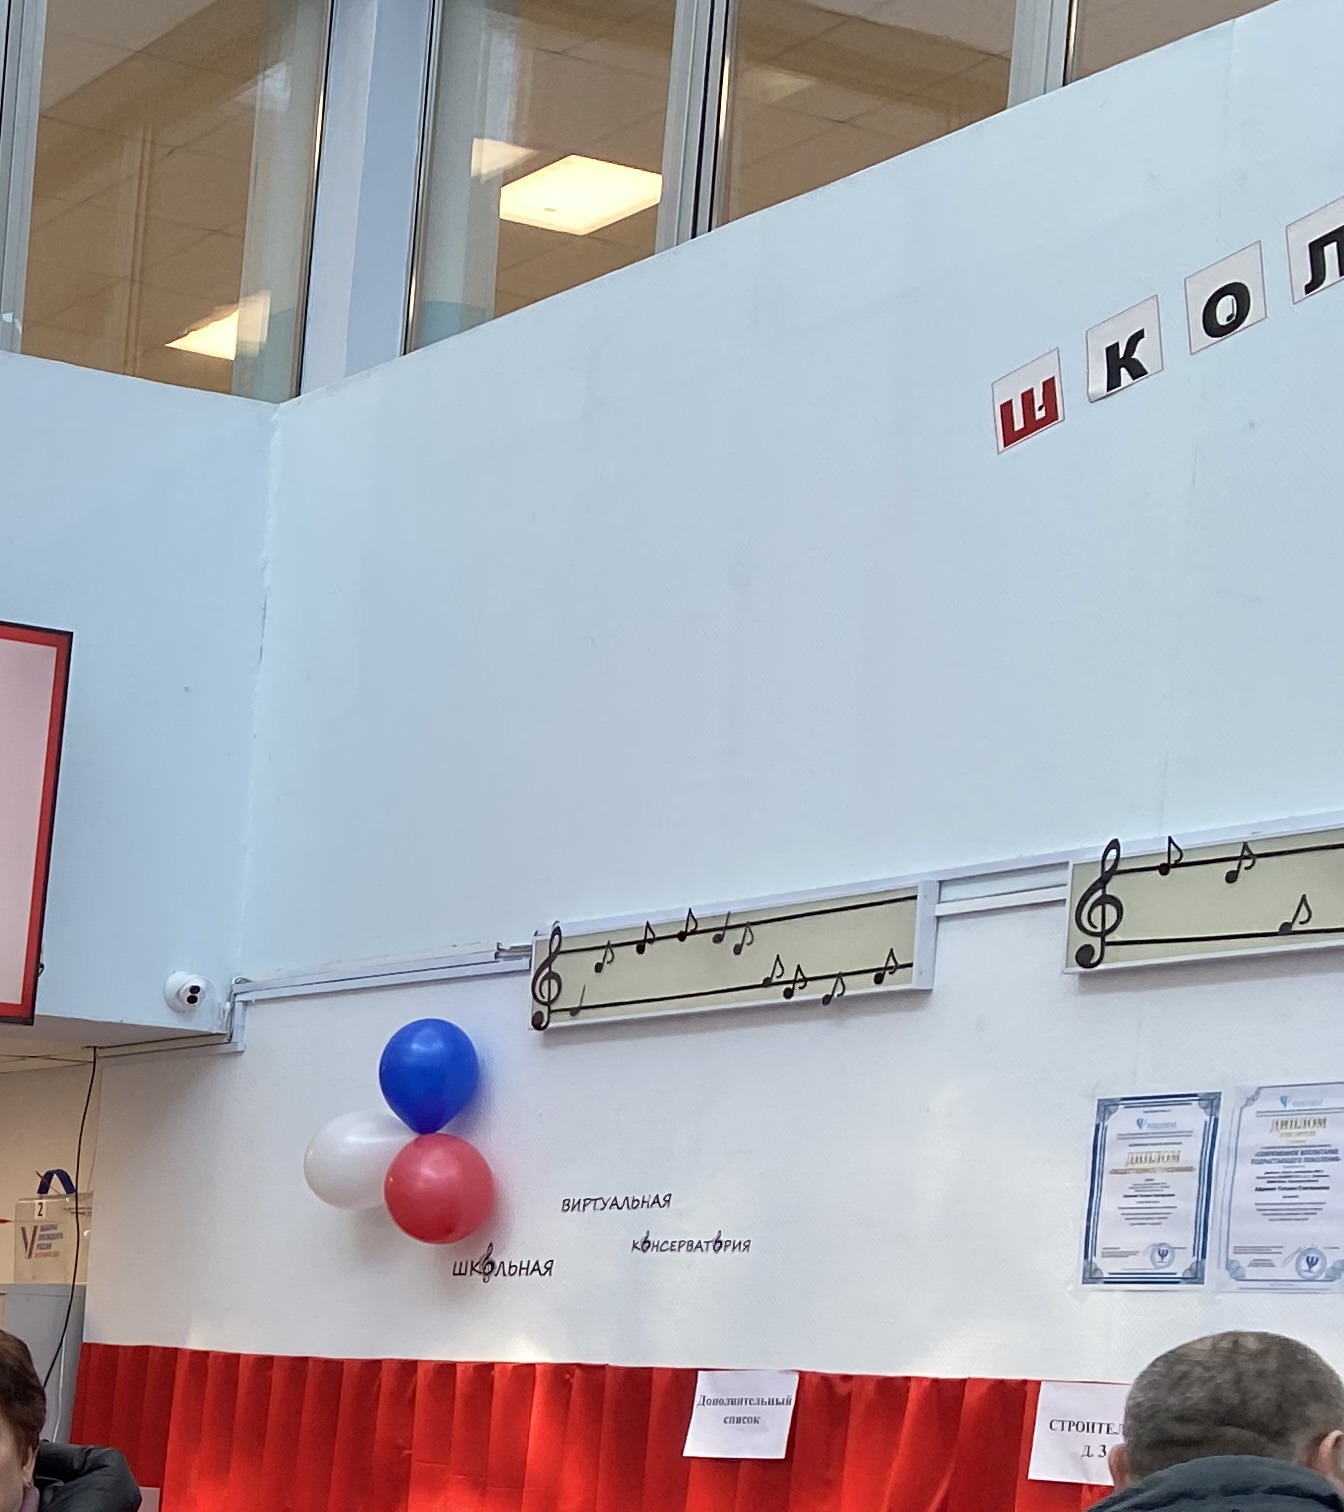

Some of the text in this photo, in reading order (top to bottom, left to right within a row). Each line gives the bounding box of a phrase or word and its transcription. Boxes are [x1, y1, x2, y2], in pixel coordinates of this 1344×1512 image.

[561, 1193, 672, 1213] ВИРТУАЛЬНАЯ
[452, 1243, 554, 1283] ШКОЛЬНАЯ
[696, 1394, 793, 1408] Дополнительный
[723, 1415, 761, 1425] список
[1098, 1444, 1107, 1458] 3
